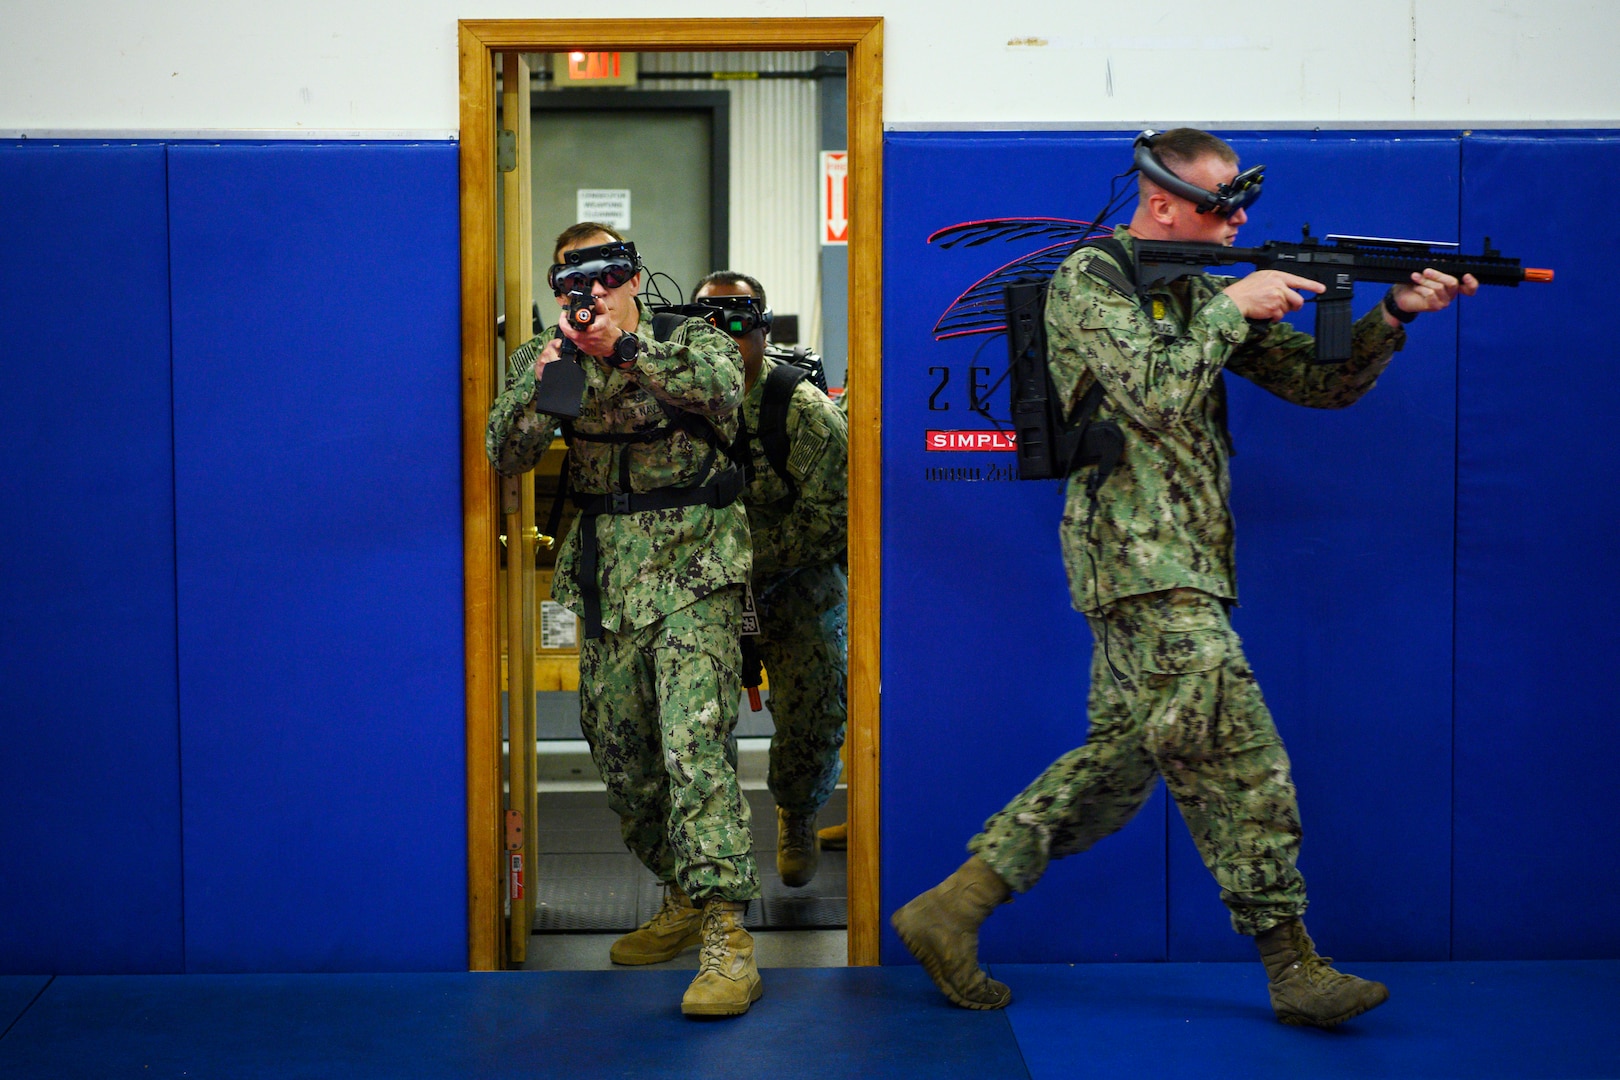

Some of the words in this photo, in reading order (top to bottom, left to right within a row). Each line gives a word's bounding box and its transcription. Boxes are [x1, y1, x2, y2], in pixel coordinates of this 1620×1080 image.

[568, 52, 620, 79] EXIT
[928, 366, 990, 411] ZE
[933, 434, 1017, 448] SIMPLY
[925, 463, 1018, 481] www.Zeb
